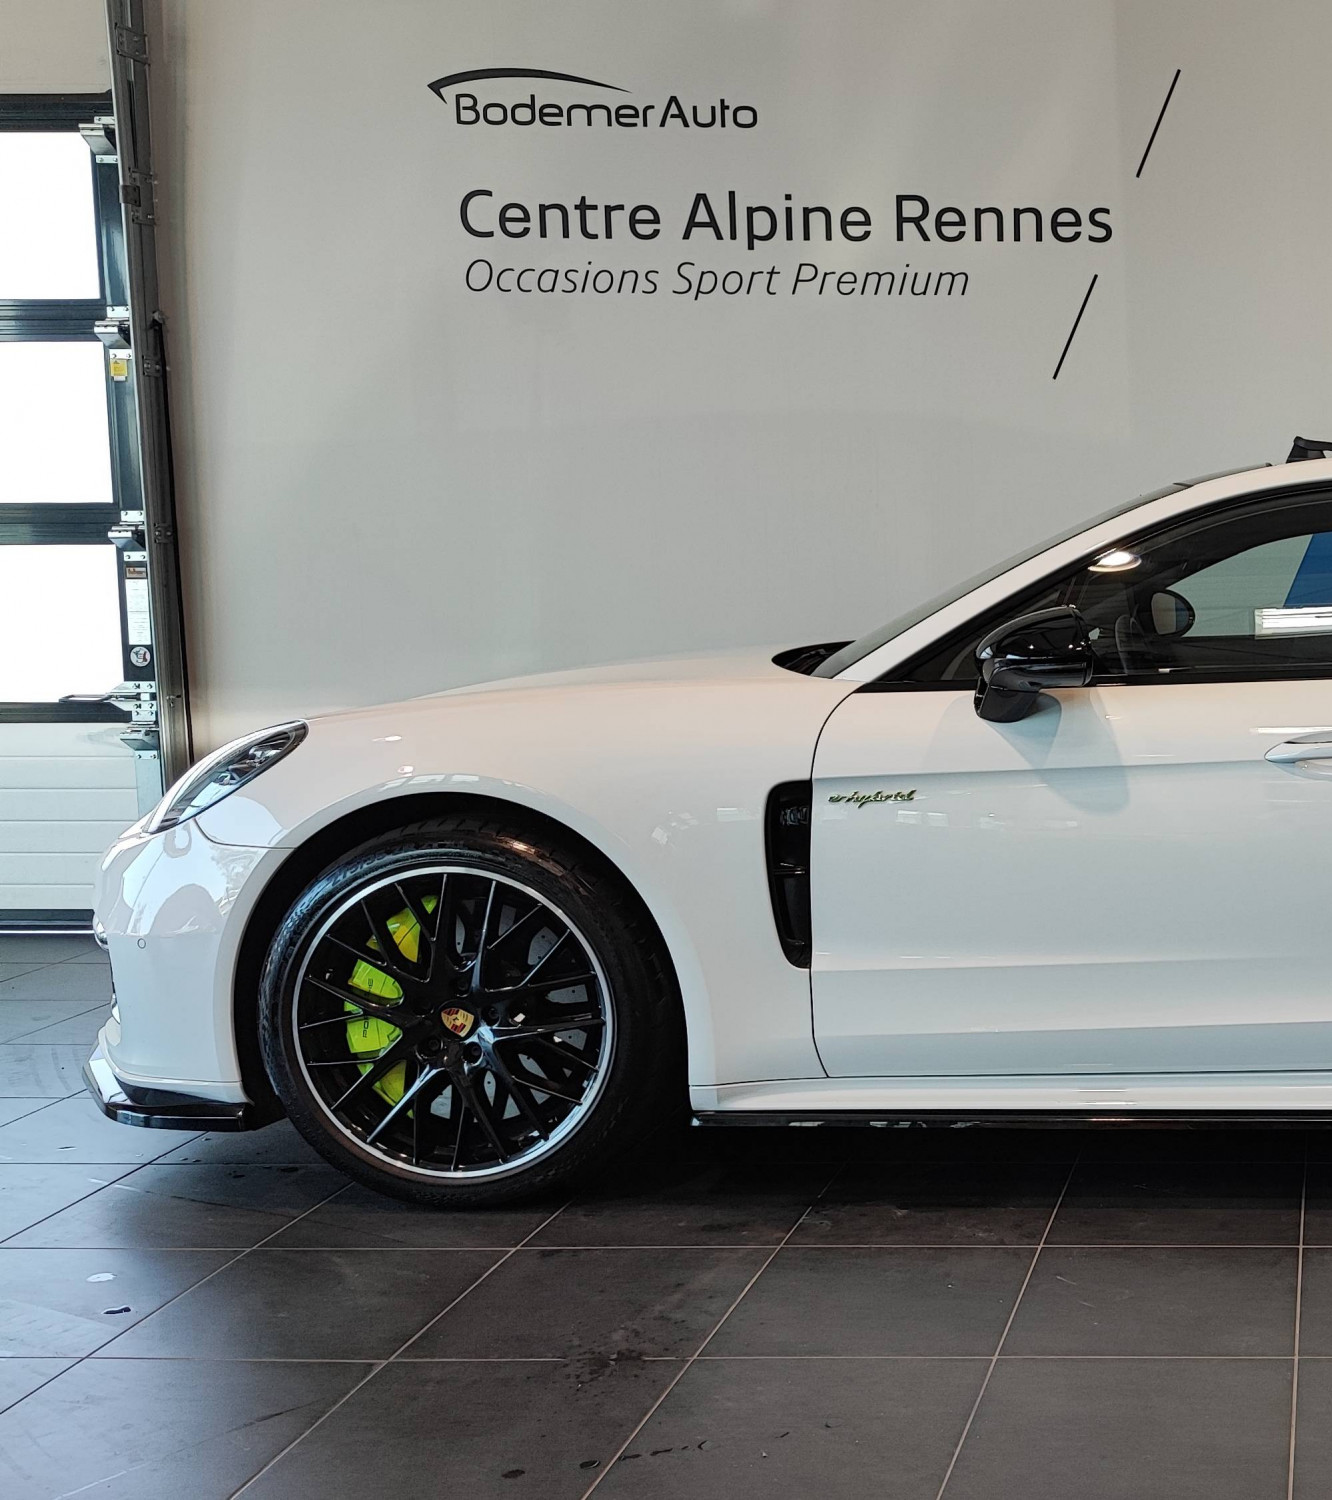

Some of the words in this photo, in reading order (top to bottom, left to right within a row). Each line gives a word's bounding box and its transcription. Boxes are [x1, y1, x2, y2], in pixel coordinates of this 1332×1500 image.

[459, 189, 661, 241] Centre
[681, 190, 872, 251] Alpine
[895, 194, 1113, 244] Rennes
[465, 258, 660, 295] Occasions
[671, 261, 781, 302] Sport
[791, 262, 969, 297] Premium
